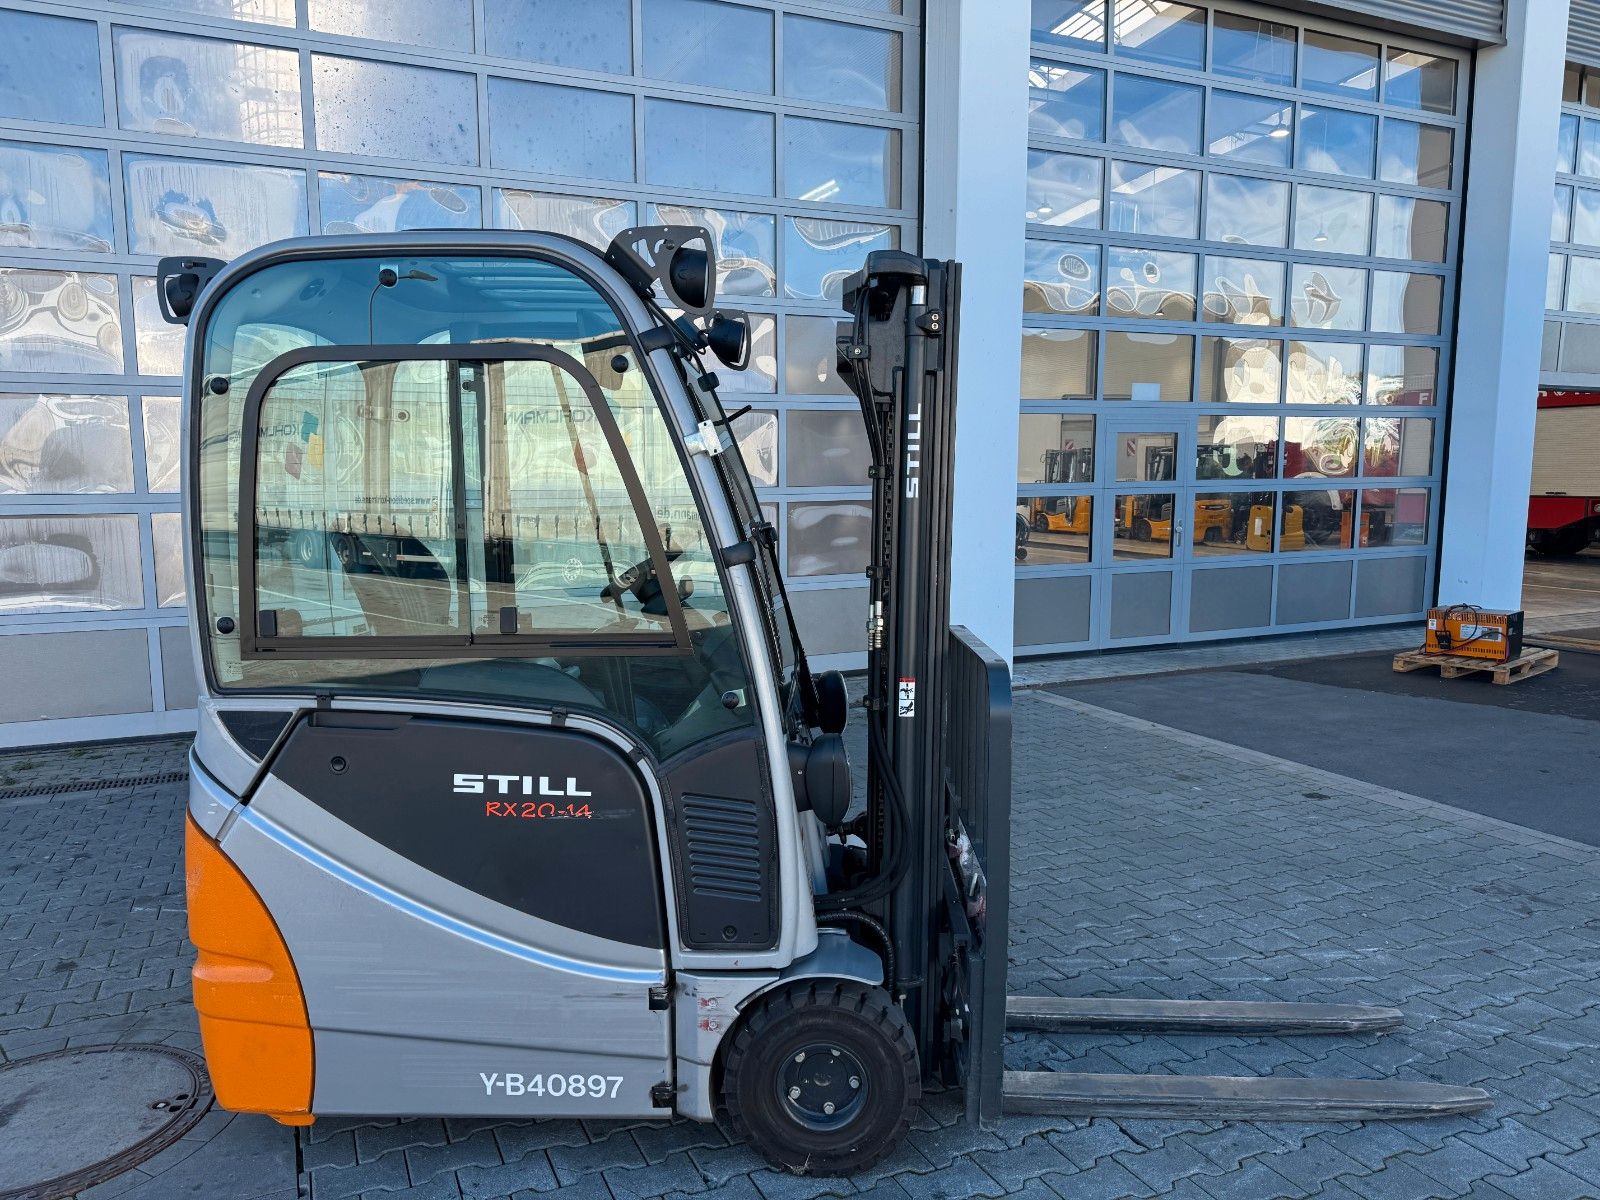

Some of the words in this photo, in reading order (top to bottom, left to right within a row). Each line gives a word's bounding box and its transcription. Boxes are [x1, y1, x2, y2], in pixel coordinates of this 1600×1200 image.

[905, 403, 922, 499] STILL
[453, 773, 592, 797] STILL
[486, 801, 592, 819] RX20-14
[479, 1072, 624, 1099] Y-B40897
